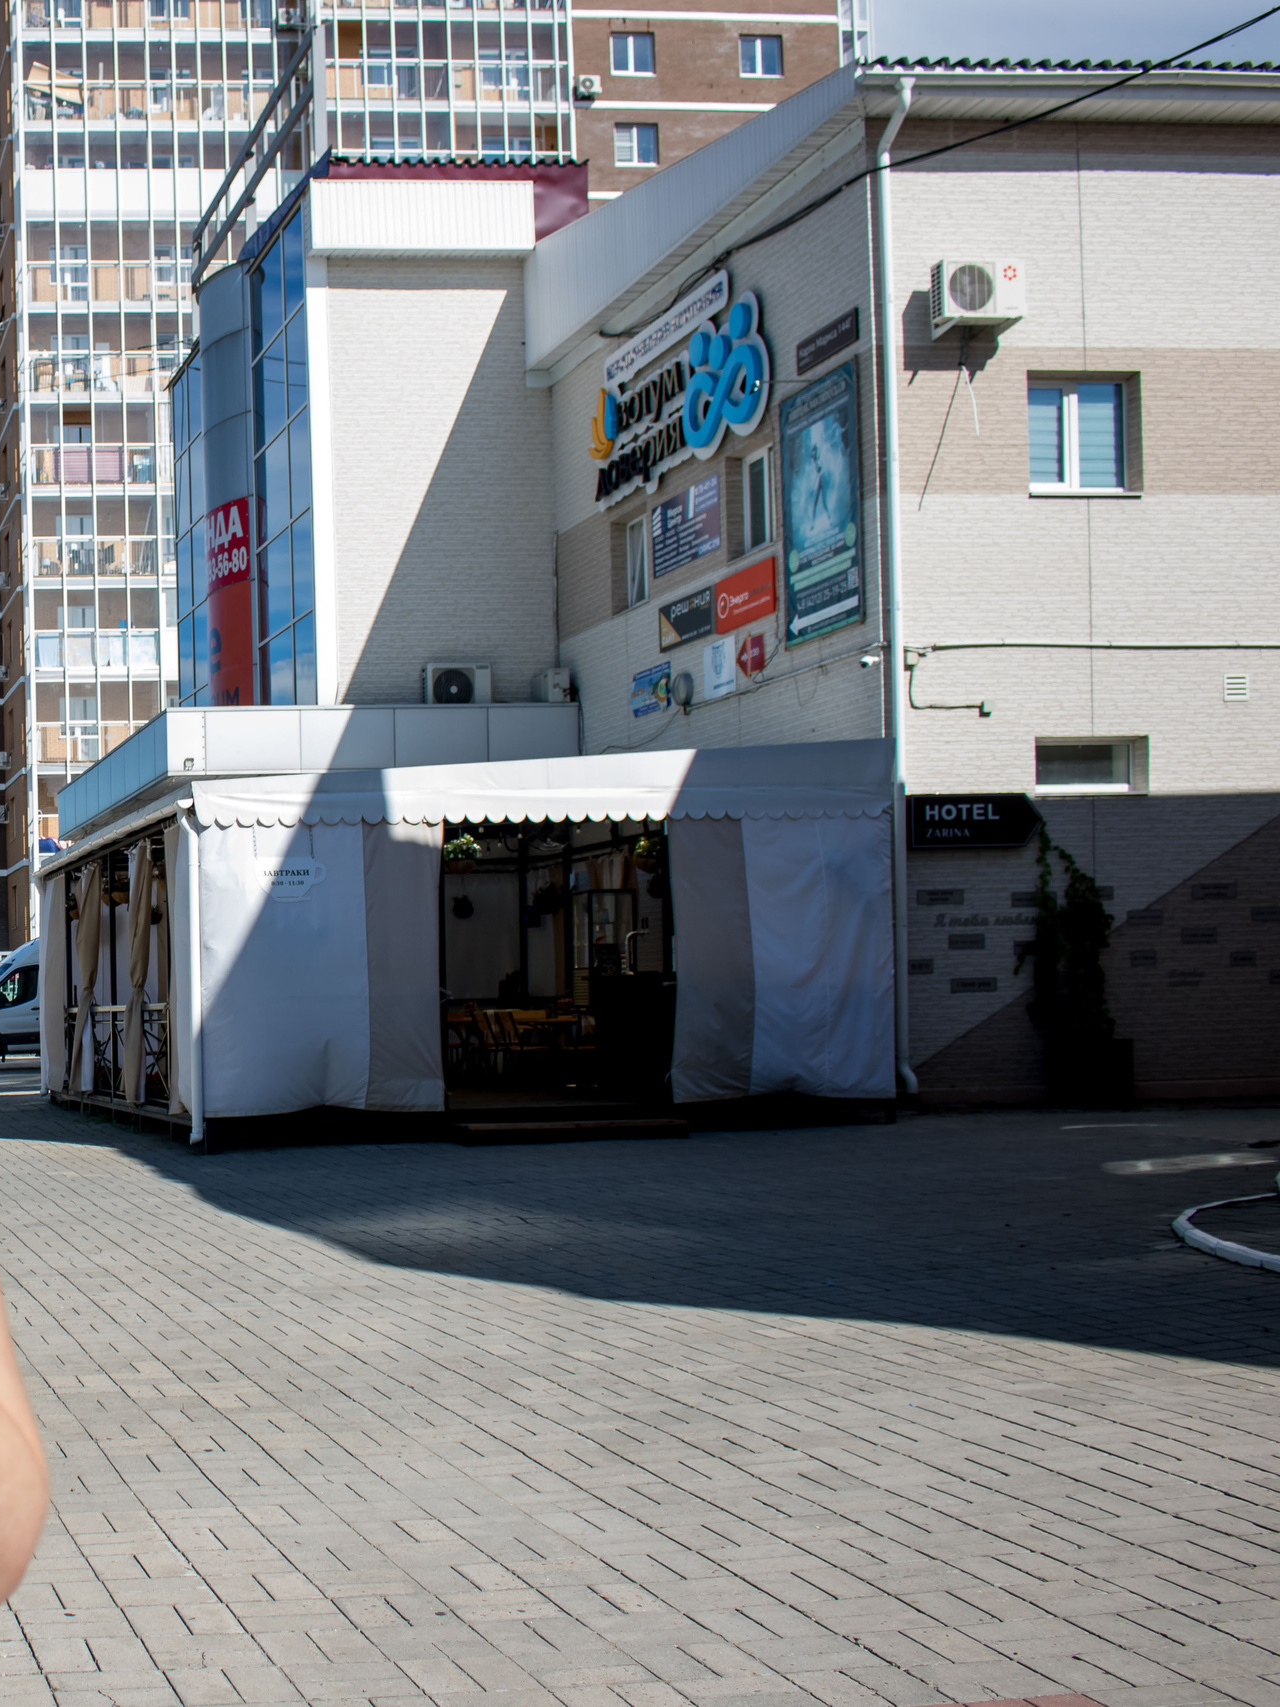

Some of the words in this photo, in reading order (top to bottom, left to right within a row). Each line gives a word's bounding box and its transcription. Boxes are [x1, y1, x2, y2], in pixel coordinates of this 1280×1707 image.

[925, 803, 1000, 821] HOTEL
[926, 828, 970, 838] ZARINA
[263, 869, 310, 877] ЗАВТРАКИ
[933, 913, 947, 928] Я
[948, 913, 989, 927] тебя
